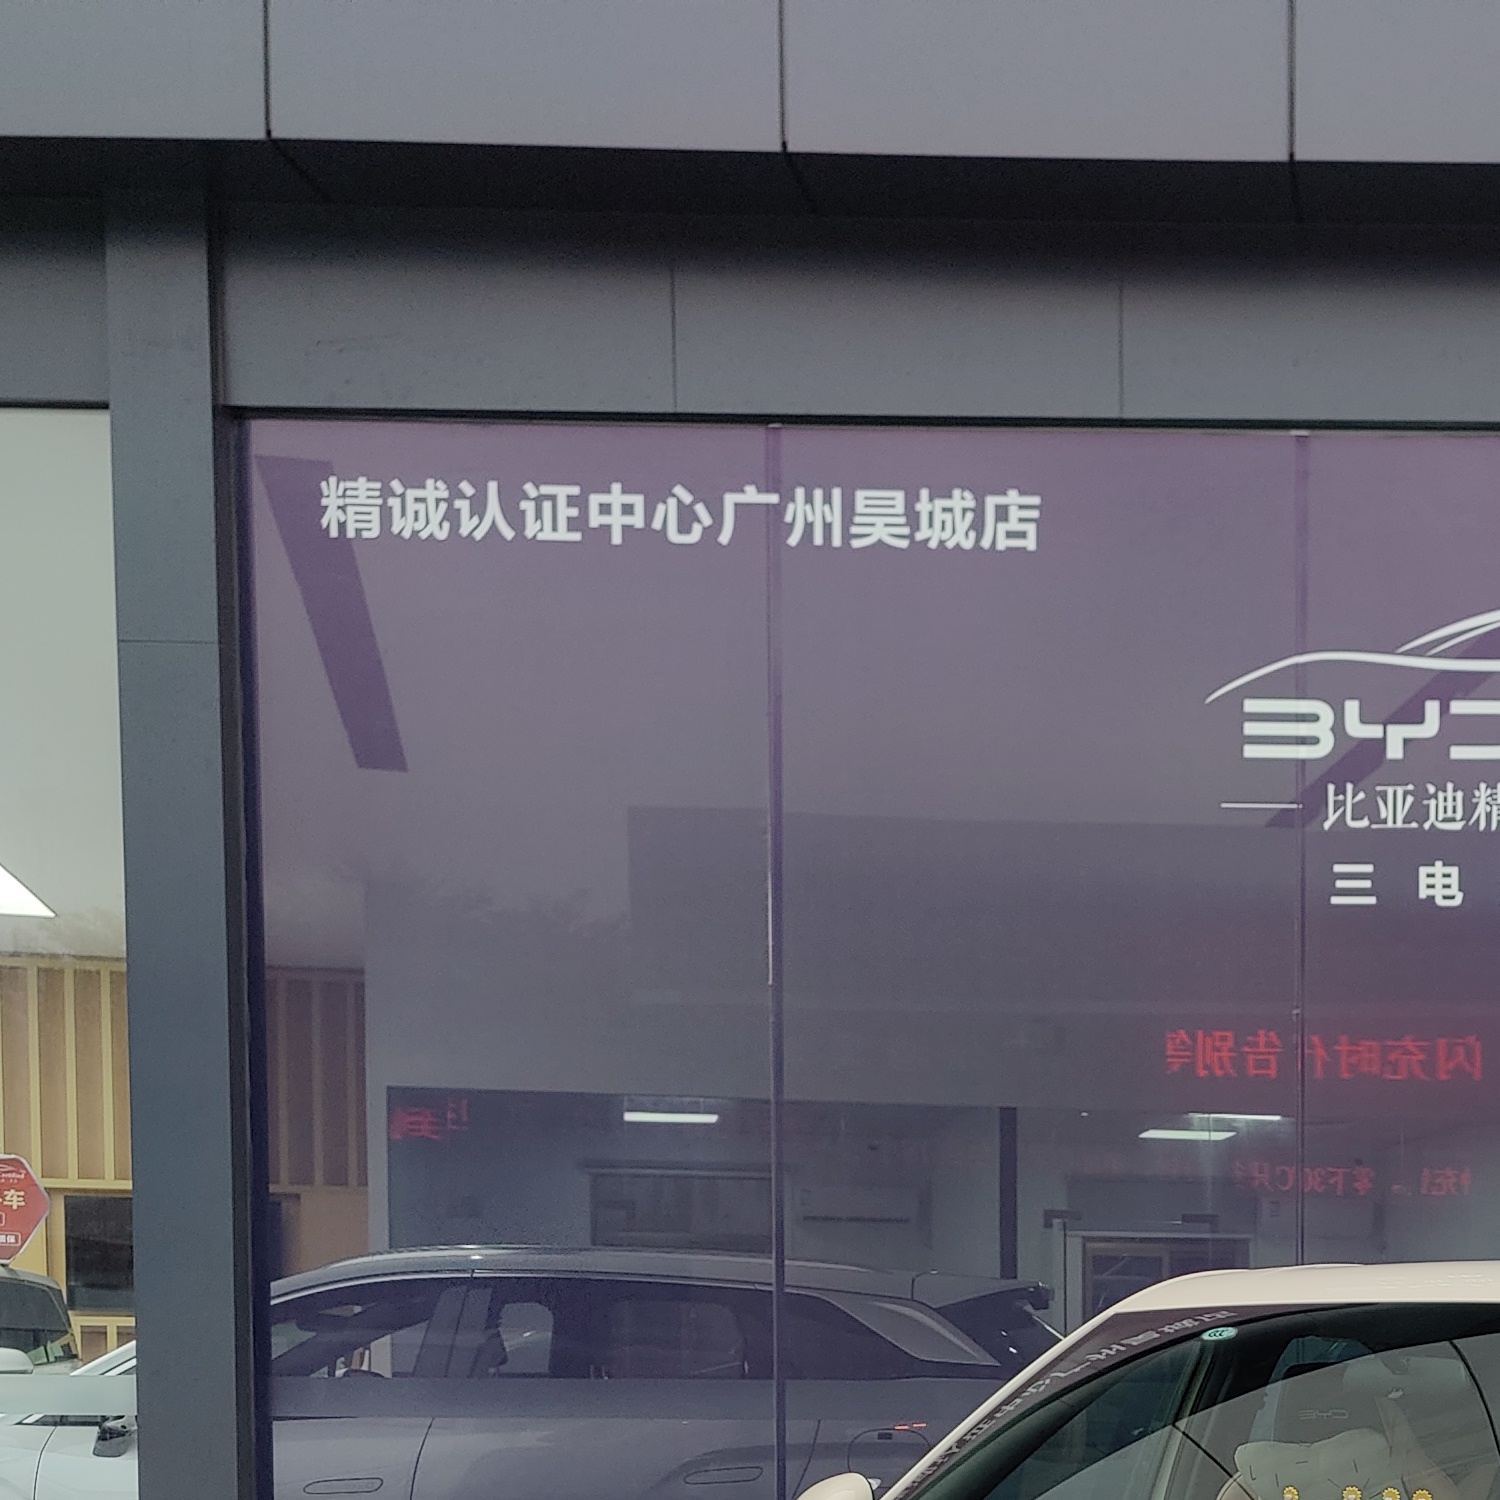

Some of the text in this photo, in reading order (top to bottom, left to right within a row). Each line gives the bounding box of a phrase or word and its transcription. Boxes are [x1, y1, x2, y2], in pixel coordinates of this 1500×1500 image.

[319, 475, 1043, 553] 精诚认证中心广州昊城店
